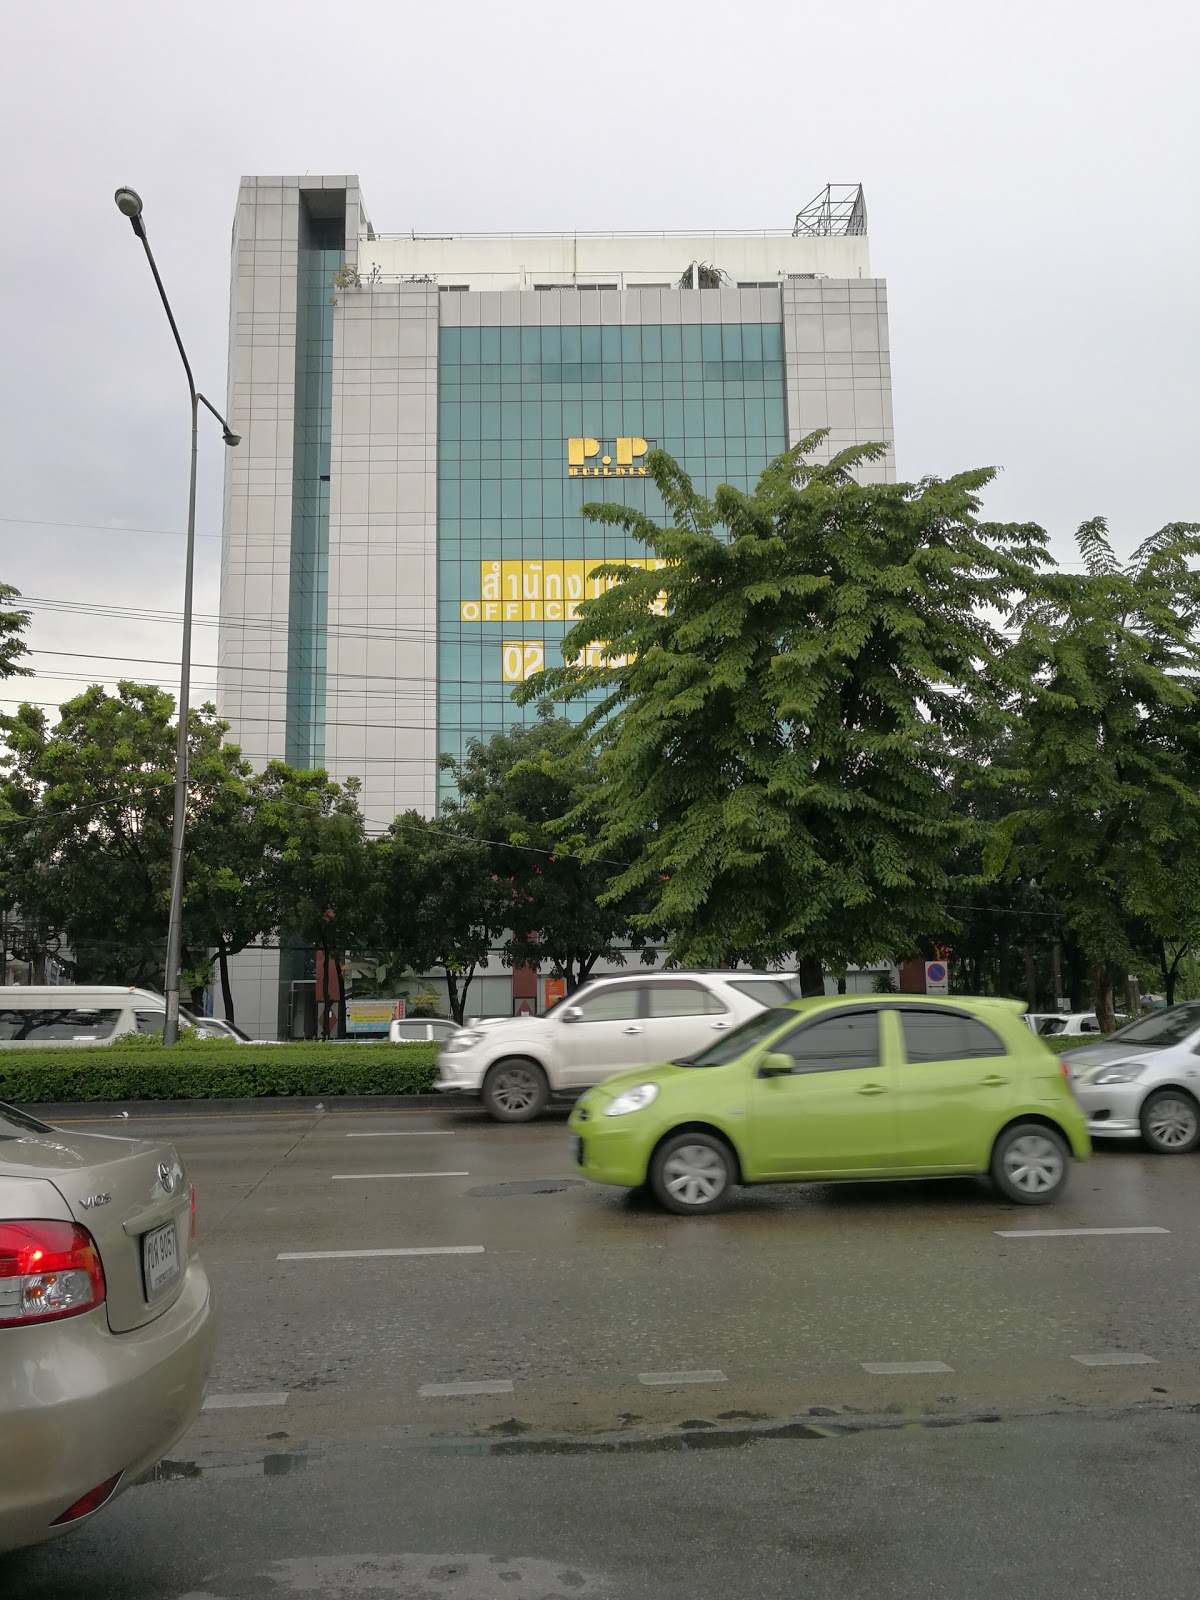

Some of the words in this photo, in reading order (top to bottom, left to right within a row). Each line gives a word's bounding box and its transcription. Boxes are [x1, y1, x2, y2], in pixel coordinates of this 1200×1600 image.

[568, 437, 648, 466] P.P
[568, 467, 648, 476] BUILDIN
[462, 602, 583, 620] OFFICE
[504, 644, 544, 679] 02
[79, 1192, 112, 1210] VIOS
